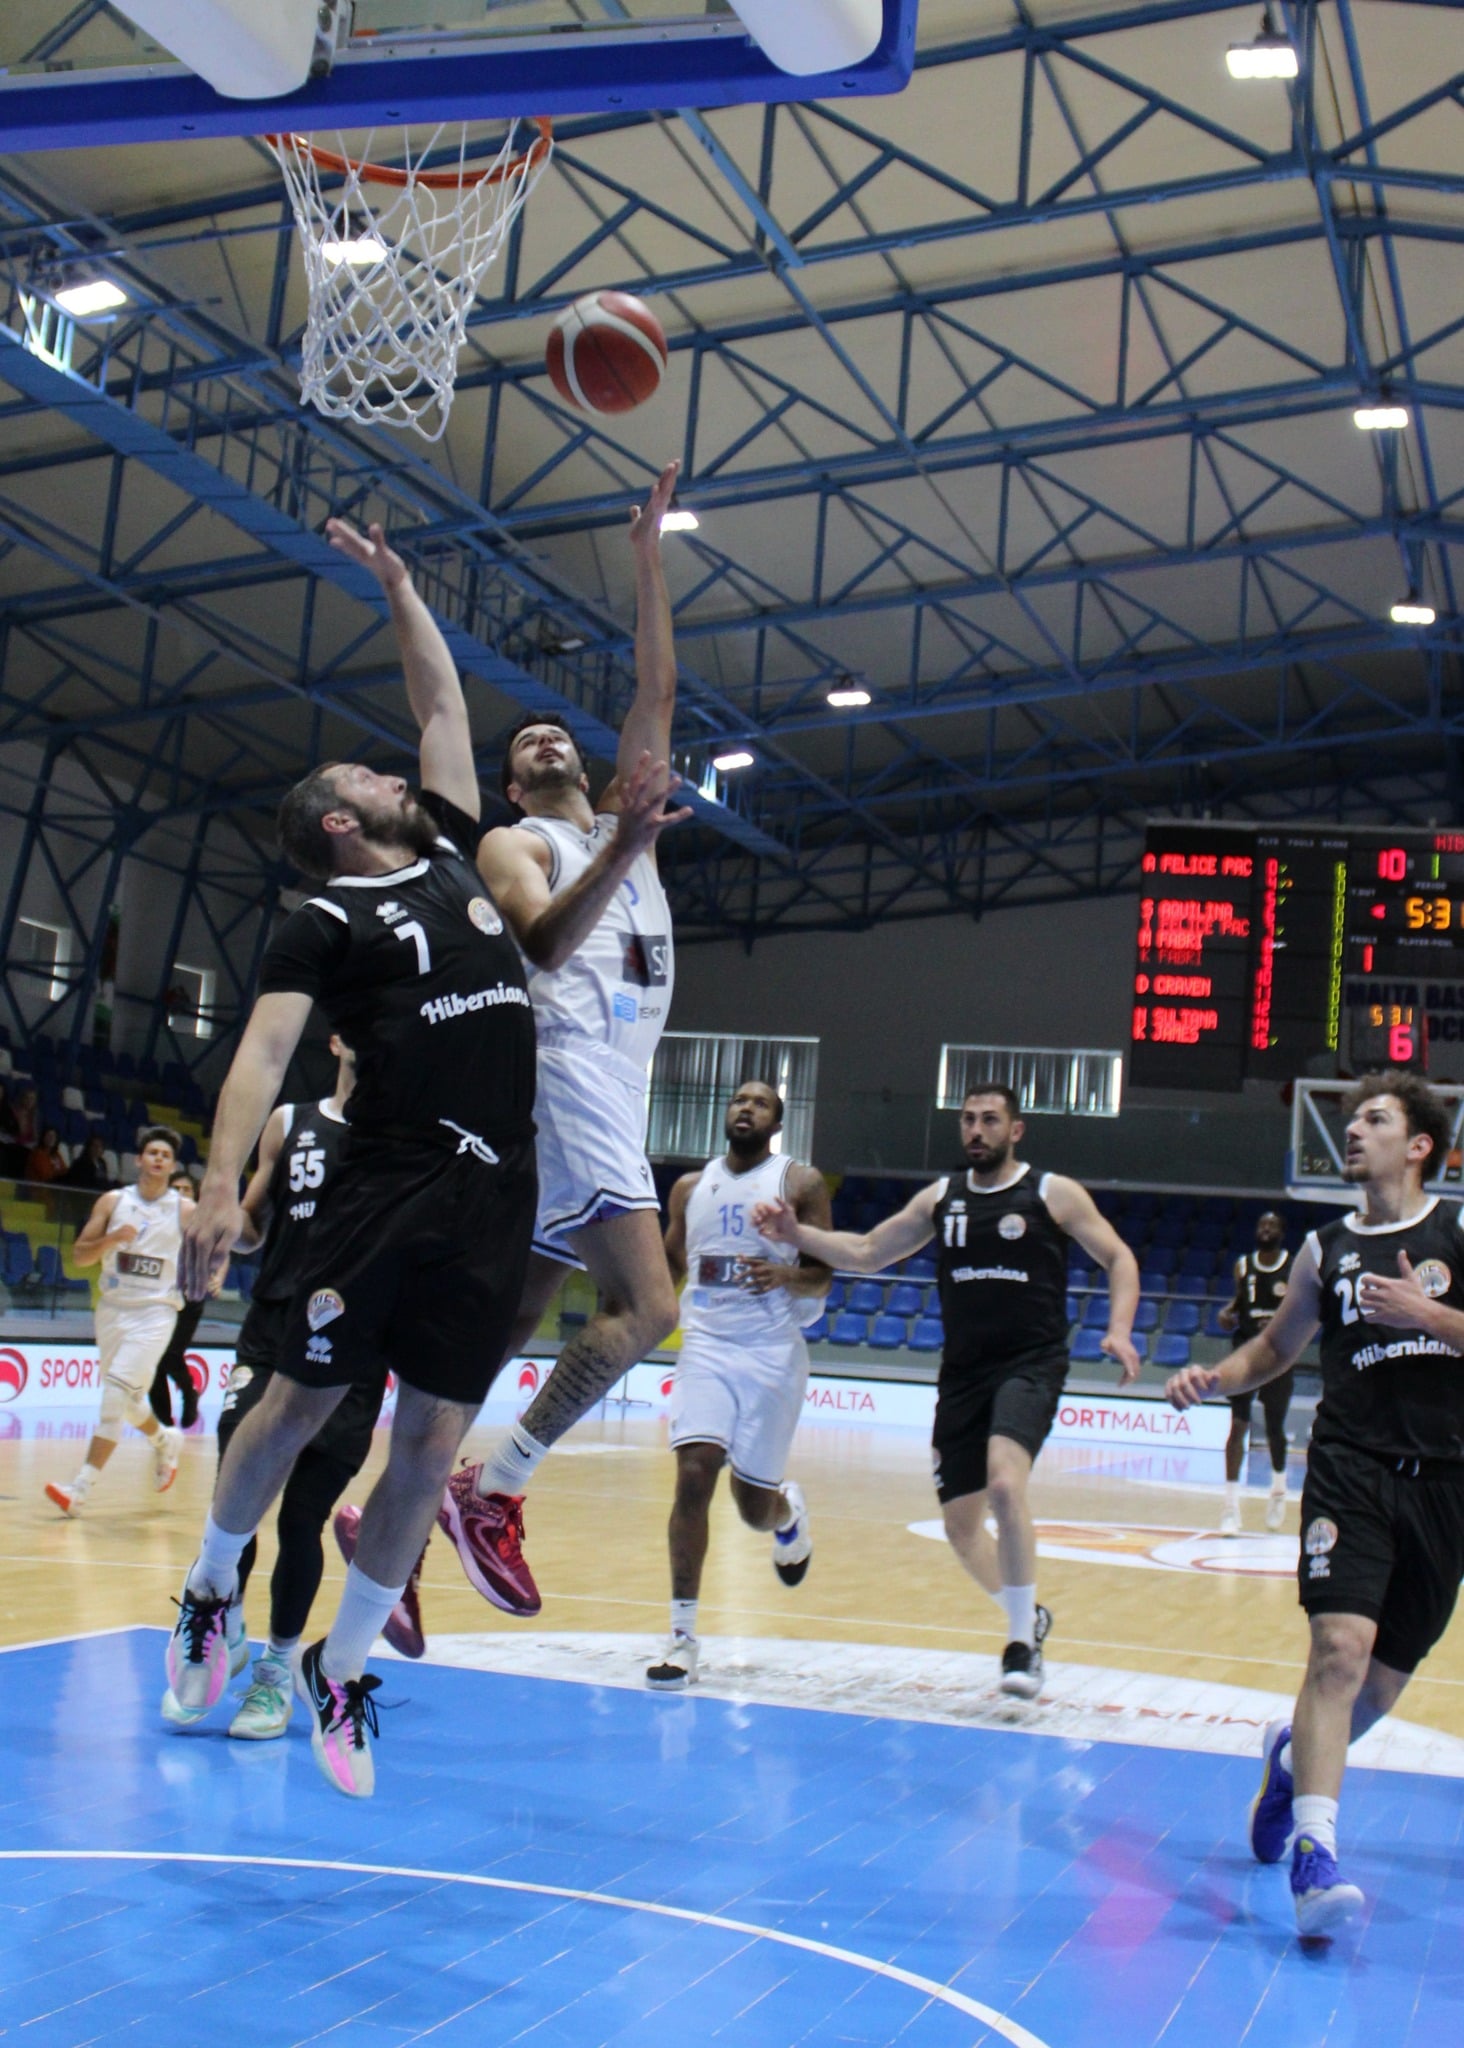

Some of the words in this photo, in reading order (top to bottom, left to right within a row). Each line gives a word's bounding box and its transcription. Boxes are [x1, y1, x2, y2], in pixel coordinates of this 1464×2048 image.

[1159, 853, 1217, 876] FELICE
[1377, 848, 1407, 881] 10
[1158, 899, 1234, 922] AQUILINA
[393, 920, 431, 976] 7
[1153, 974, 1212, 998] CRAVEN
[1388, 1023, 1413, 1061] 6
[289, 1149, 326, 1189] 55
[718, 1203, 745, 1237] 15
[943, 1214, 968, 1248] 11
[131, 1258, 160, 1276] JSD
